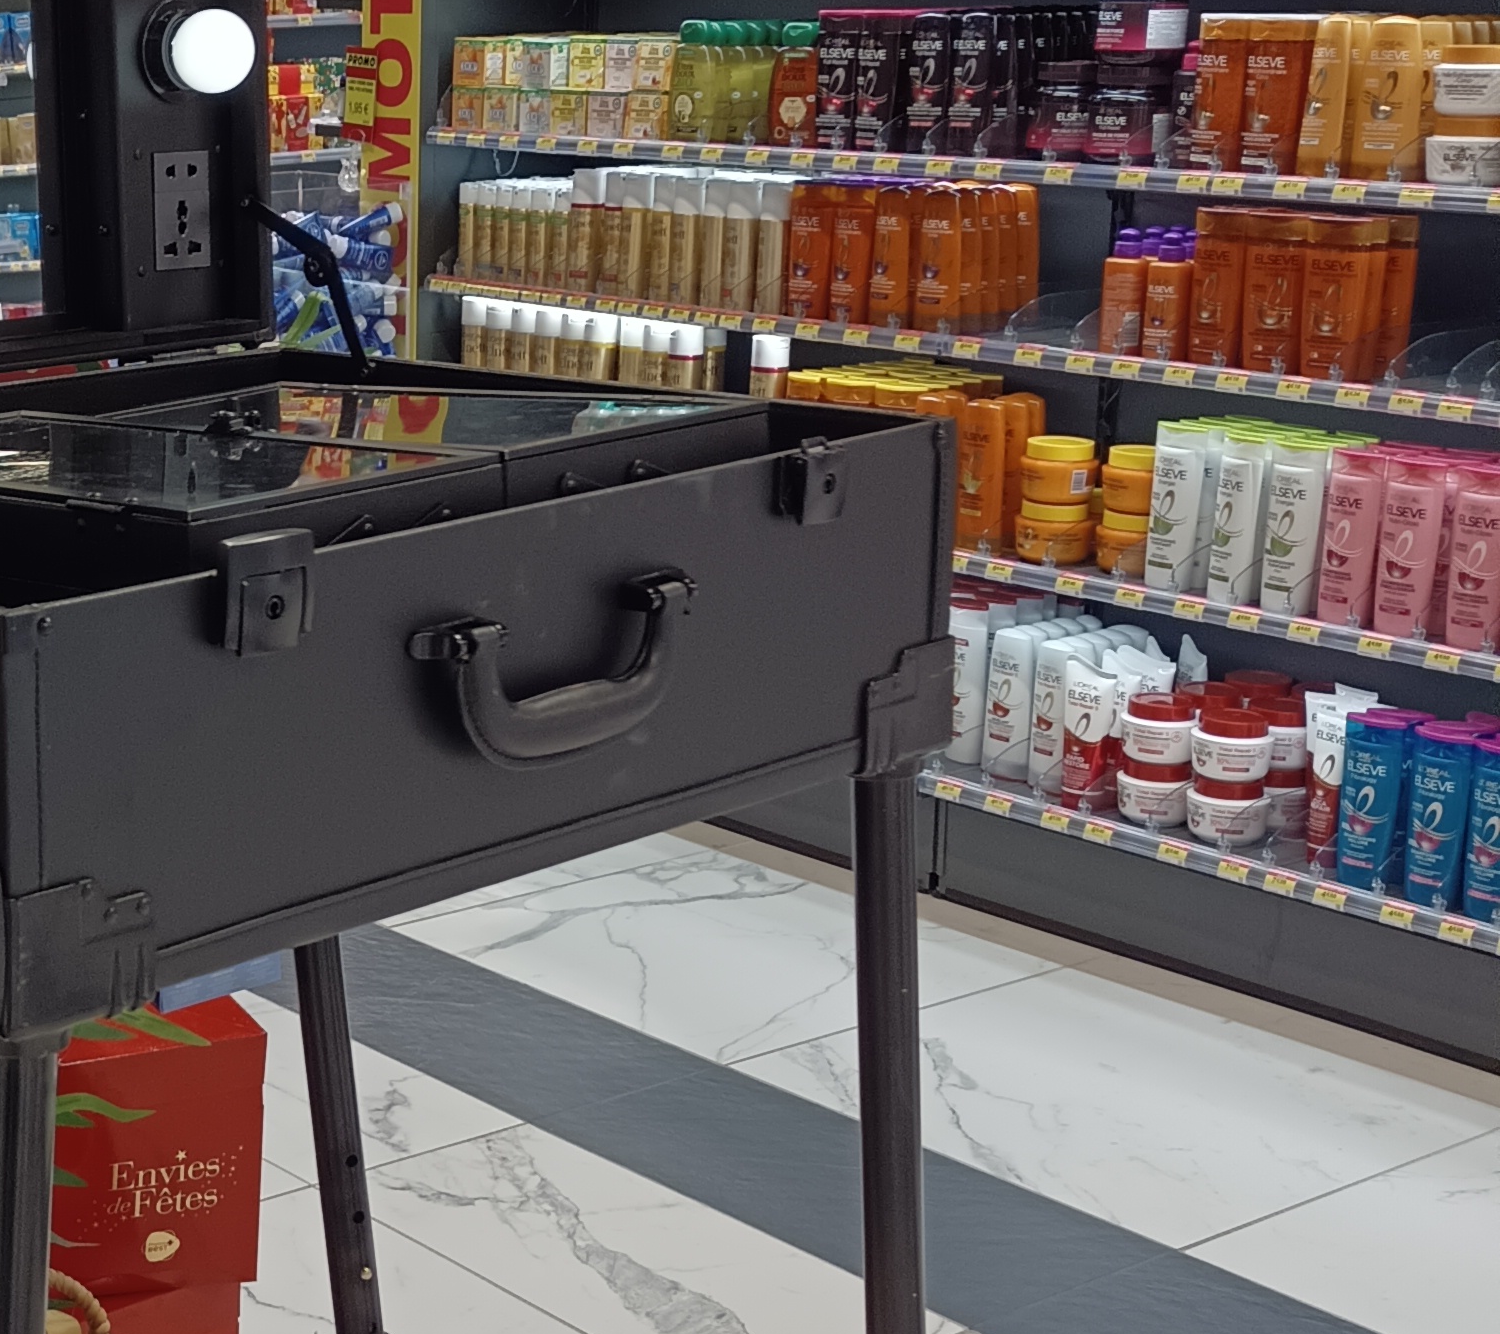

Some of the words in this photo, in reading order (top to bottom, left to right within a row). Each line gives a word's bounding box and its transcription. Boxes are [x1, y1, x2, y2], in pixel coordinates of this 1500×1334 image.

[912, 39, 943, 51] ELSEVE
[347, 55, 376, 68] PROMO
[820, 47, 855, 60] ELSEVE
[858, 47, 887, 61] ELSEVE
[1197, 54, 1228, 67] ELSEVE
[1248, 55, 1285, 68] ELSEVE
[1370, 49, 1410, 61] ELSEVE
[1095, 116, 1127, 126] ELSEVE
[1254, 253, 1300, 267] ELSEVE
[1311, 258, 1356, 272] ELSEVE
[1155, 465, 1187, 481] ELSEVE
[1270, 484, 1307, 501] ELSEVE
[1328, 493, 1363, 511] ELSEVE
[1386, 503, 1427, 520] ELSEVE
[1457, 514, 1500, 530] ELSEVE
[1067, 689, 1102, 706] ELSEVE
[1316, 729, 1347, 746] ELSEVE
[1346, 759, 1388, 778] ELSEVE
[1413, 775, 1456, 794] ELSEVE
[1473, 788, 1500, 805] ELSEV
[107, 1157, 221, 1192] Envies
[106, 1196, 131, 1215] de
[131, 1187, 219, 1219] Fêtes
